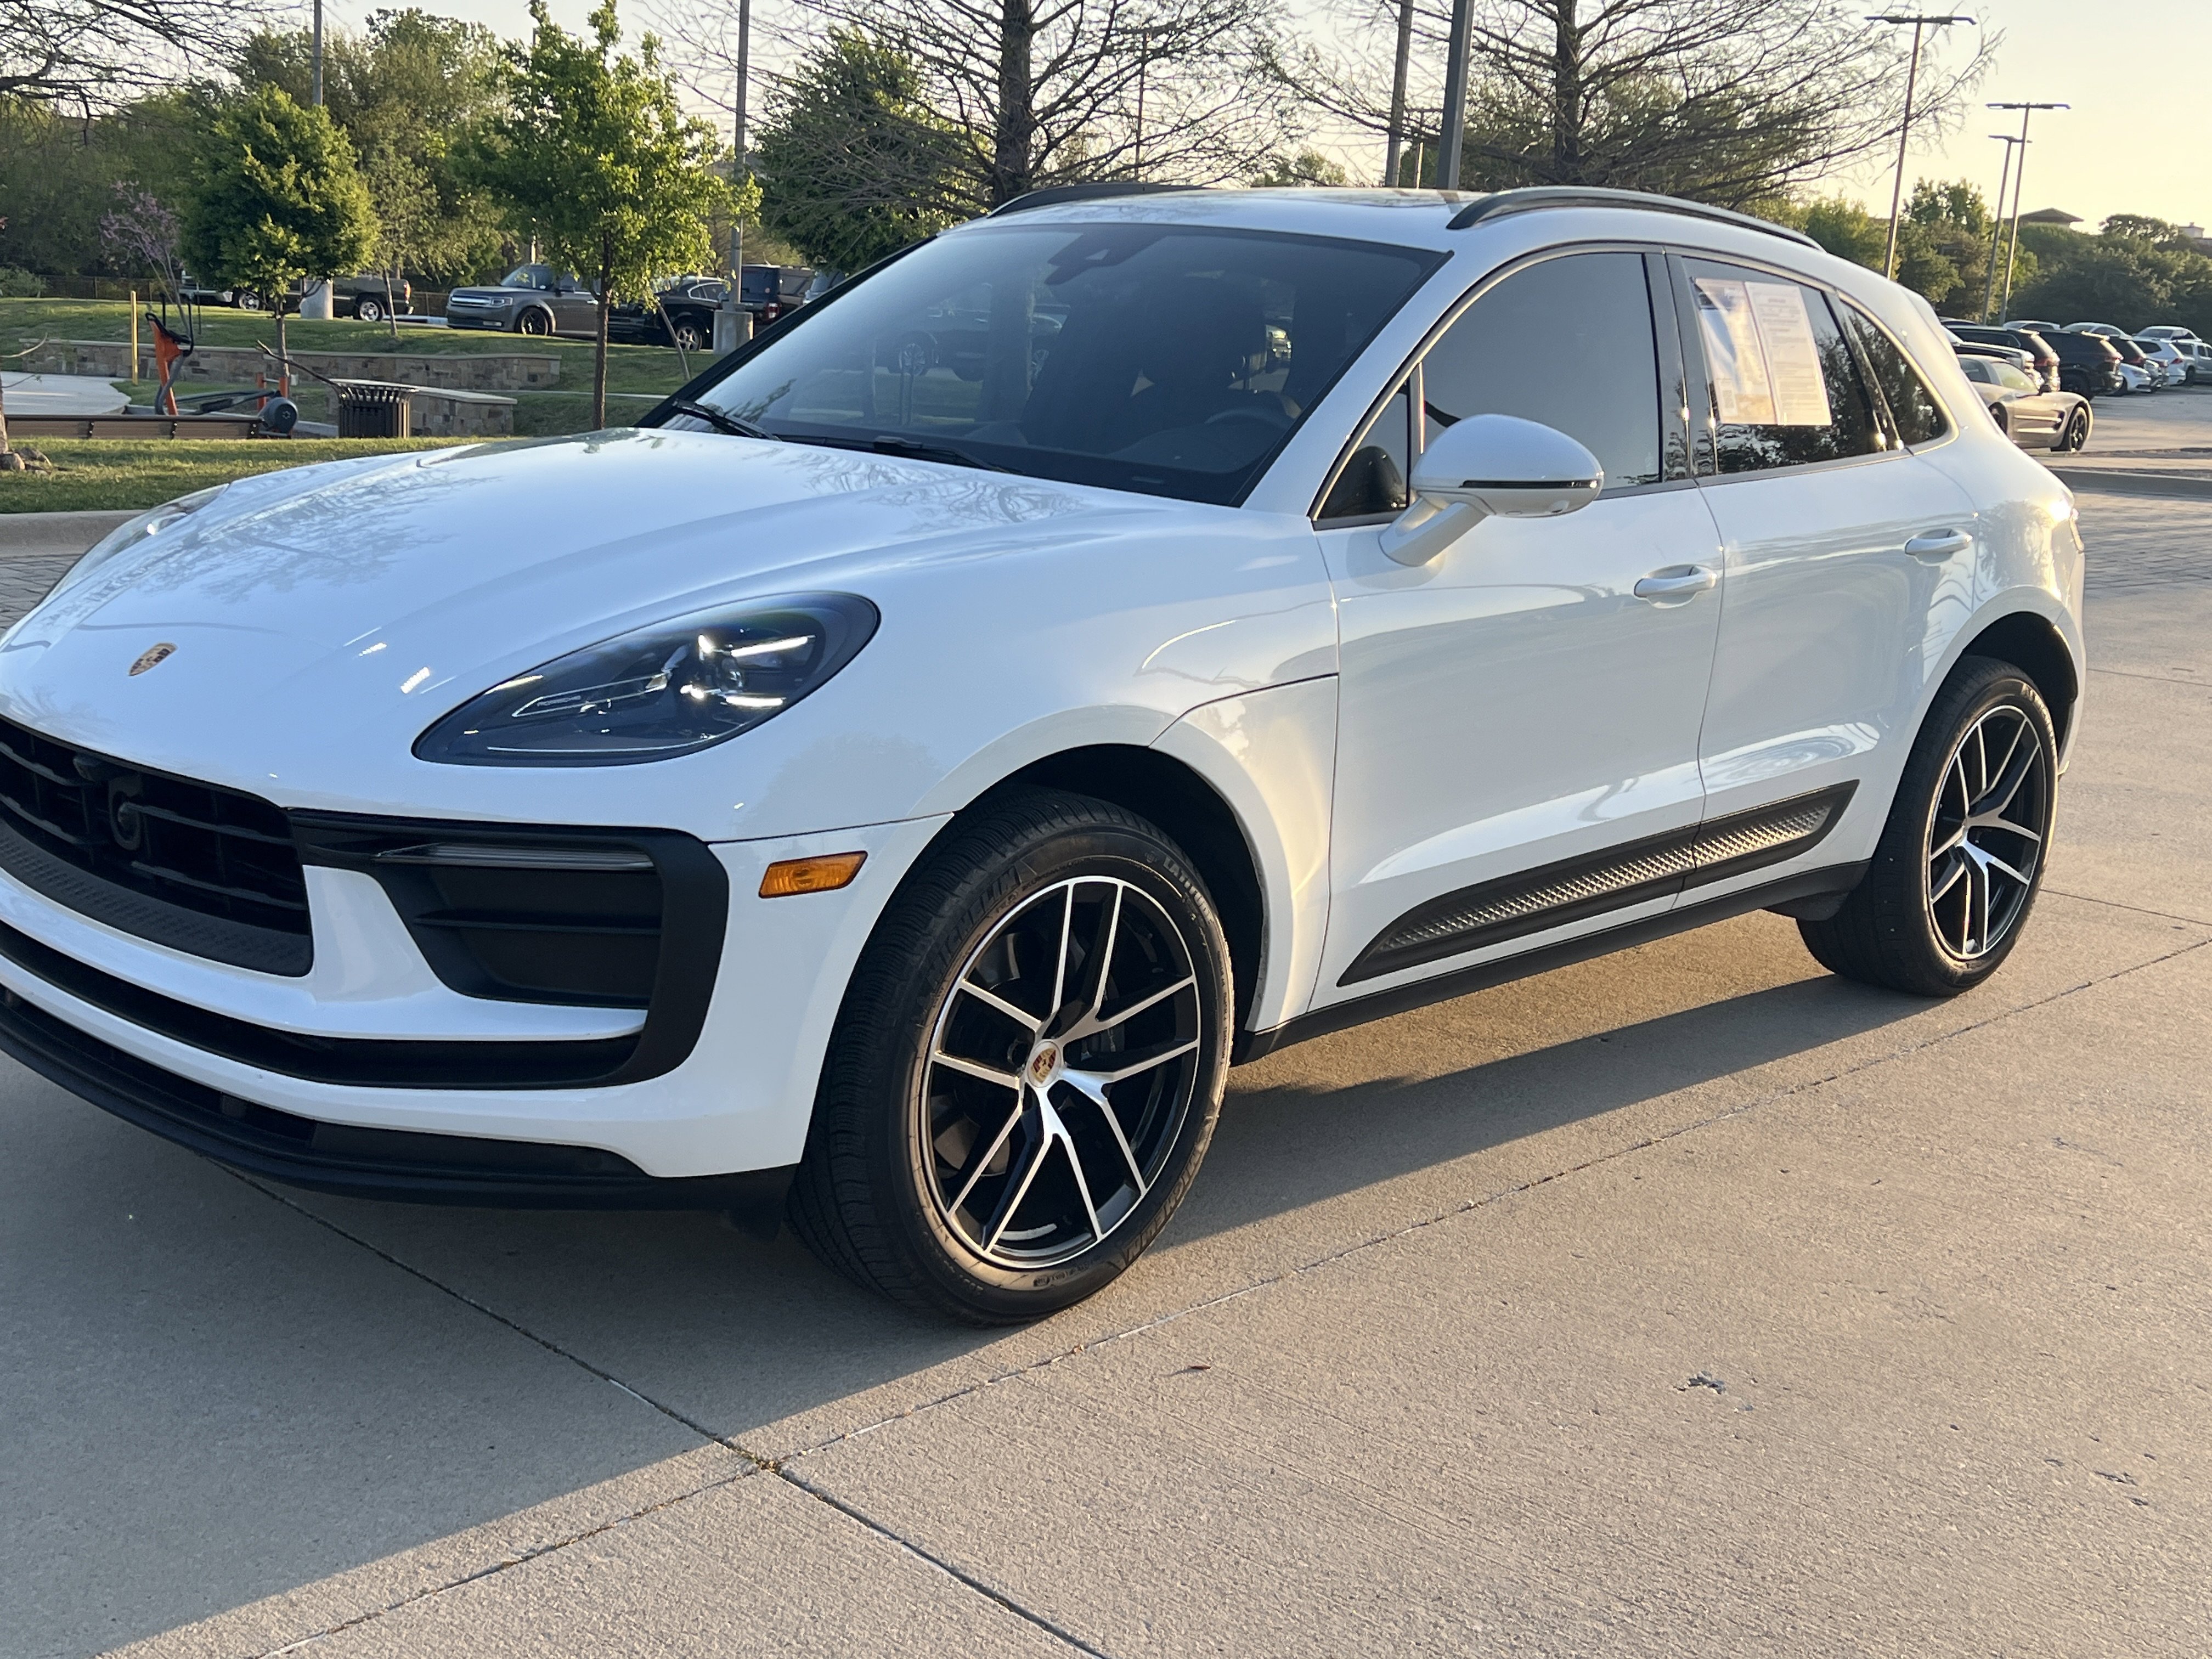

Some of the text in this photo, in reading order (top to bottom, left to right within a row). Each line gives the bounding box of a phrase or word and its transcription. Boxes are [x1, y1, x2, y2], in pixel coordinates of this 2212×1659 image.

[924, 865, 1022, 989] MICHELIN
[1161, 856, 1214, 926] LATITUDE
[1123, 1147, 1204, 1263] MICHELIN
